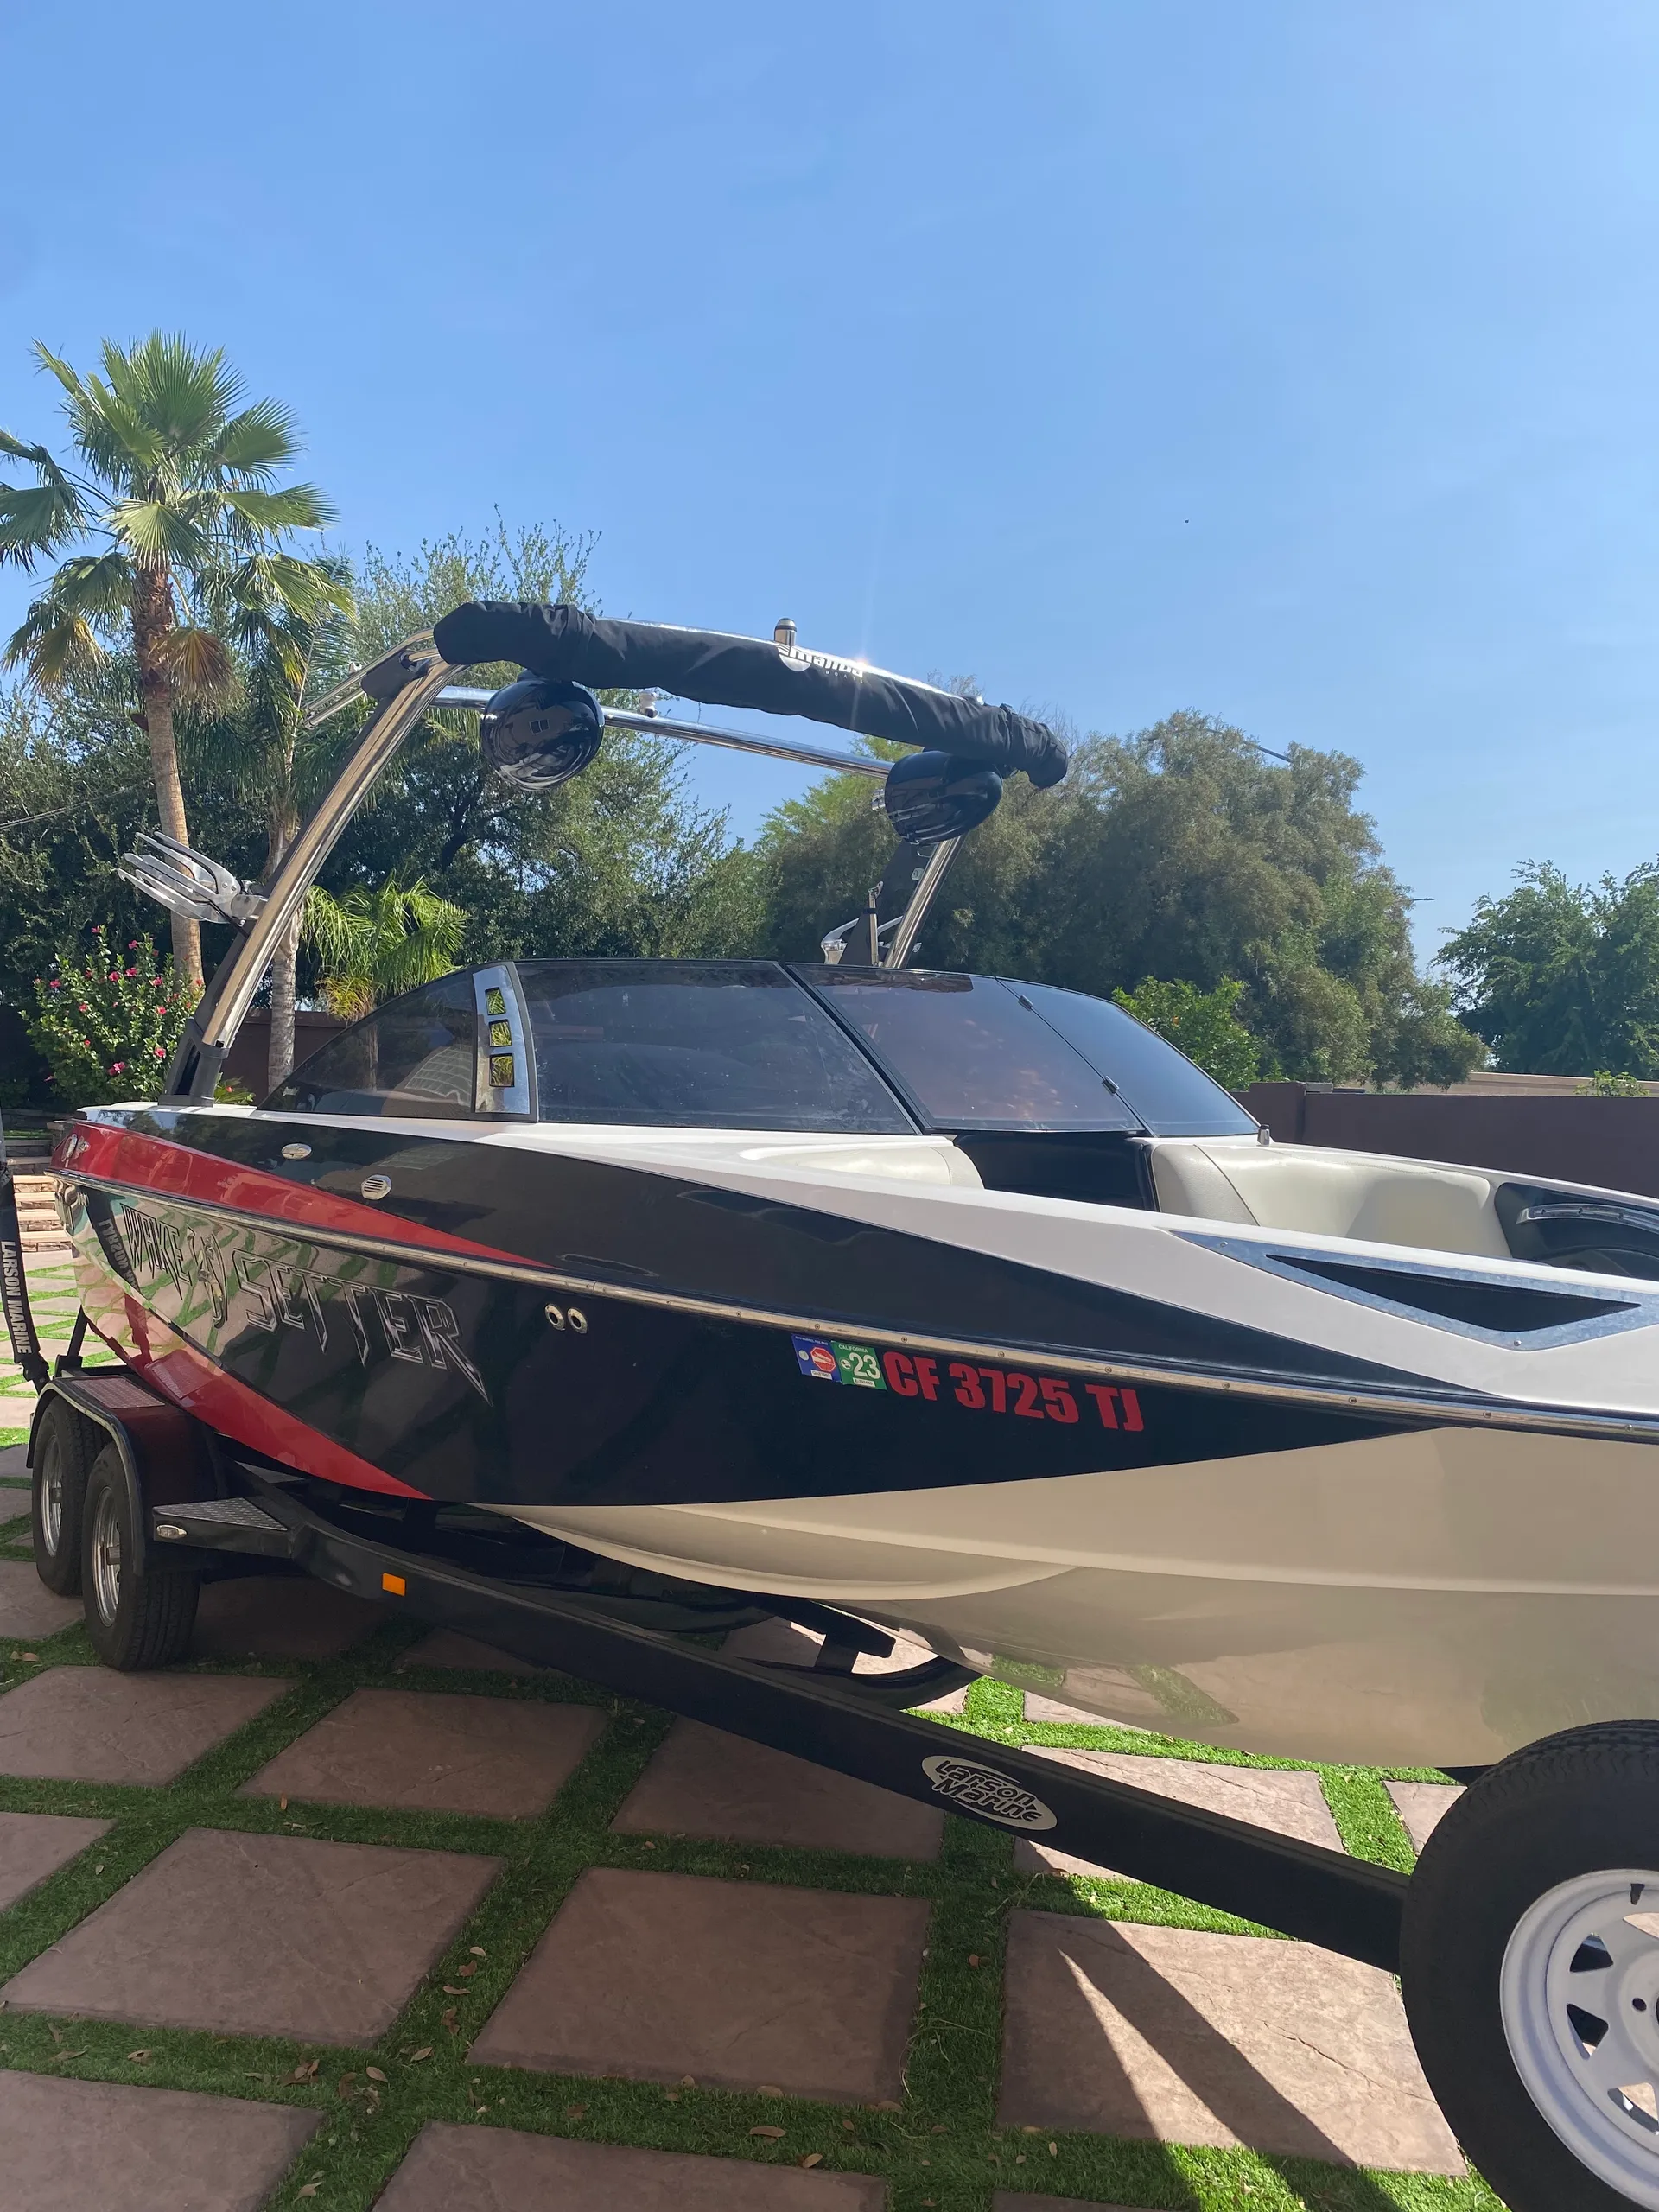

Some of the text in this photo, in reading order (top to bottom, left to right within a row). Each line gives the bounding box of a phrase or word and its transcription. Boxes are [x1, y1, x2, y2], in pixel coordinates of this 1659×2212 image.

[826, 670, 863, 684] BOATS
[1, 1241, 33, 1355] LARSON MARINE
[231, 1247, 493, 1407] SETTER
[849, 1351, 881, 1380] 23
[883, 1350, 1145, 1432] CF 3725 TJ
